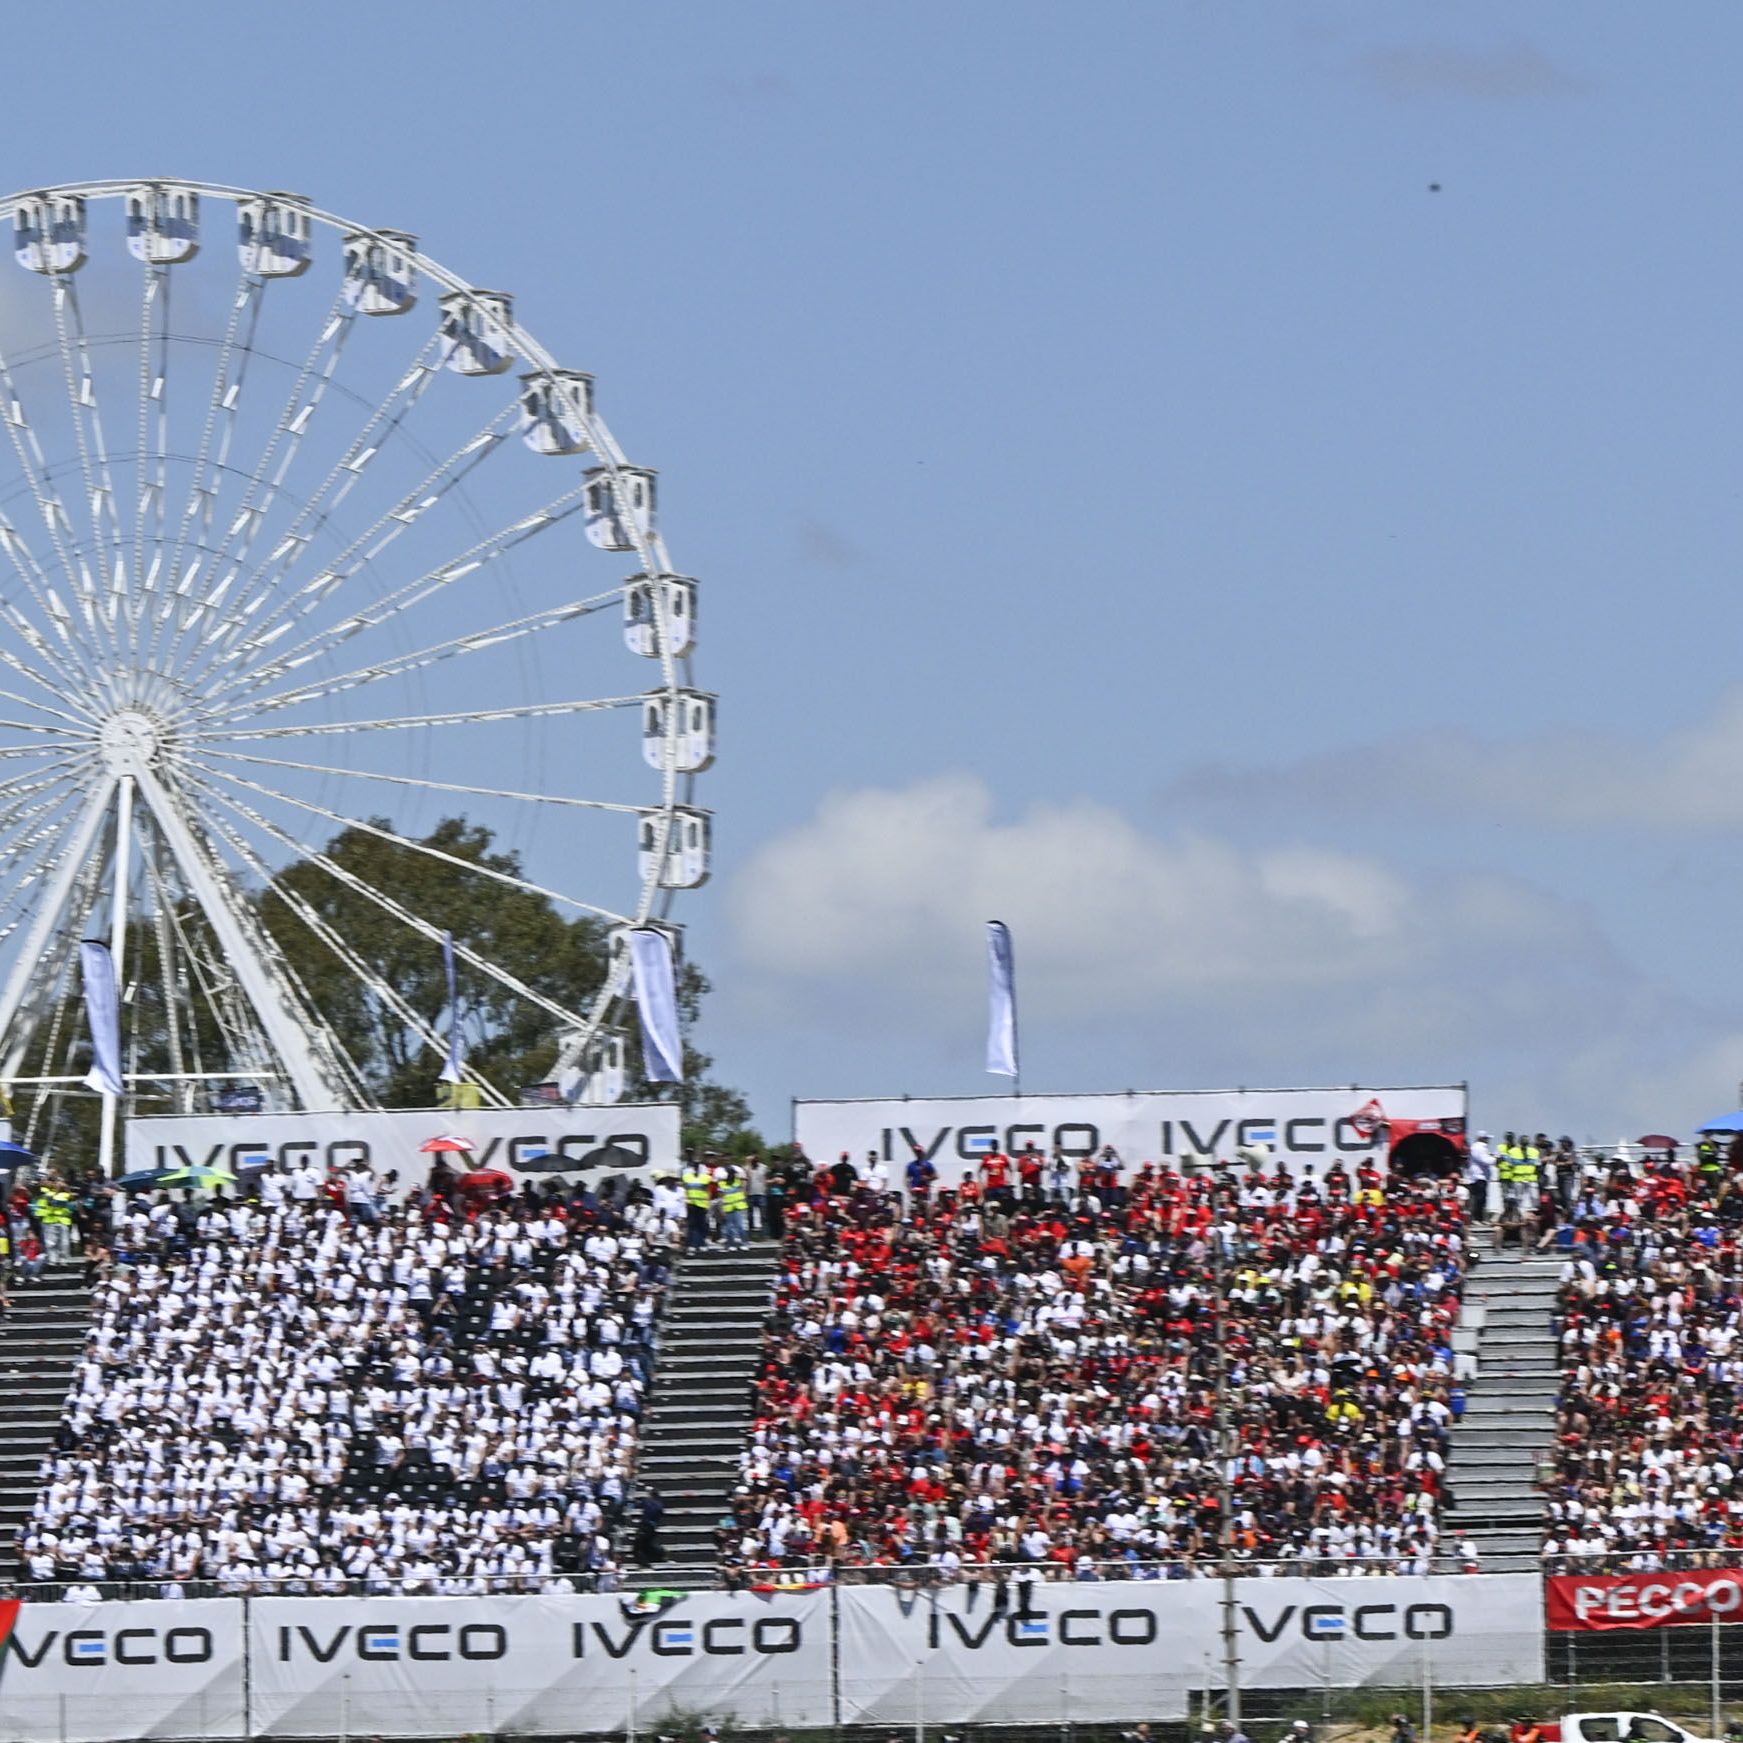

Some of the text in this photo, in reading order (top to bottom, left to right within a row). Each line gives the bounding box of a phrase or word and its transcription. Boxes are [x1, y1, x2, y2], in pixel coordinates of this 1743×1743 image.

[456, 1134, 649, 1171] VECO
[881, 1116, 1376, 1162] IVECO IVECO
[1575, 1578, 1741, 1620] PECCO
[279, 1616, 802, 1663] IVECO IVECO
[929, 1607, 1158, 1649] IVECO
[1243, 1602, 1454, 1642] VECO
[8, 1626, 213, 1669] VECO
